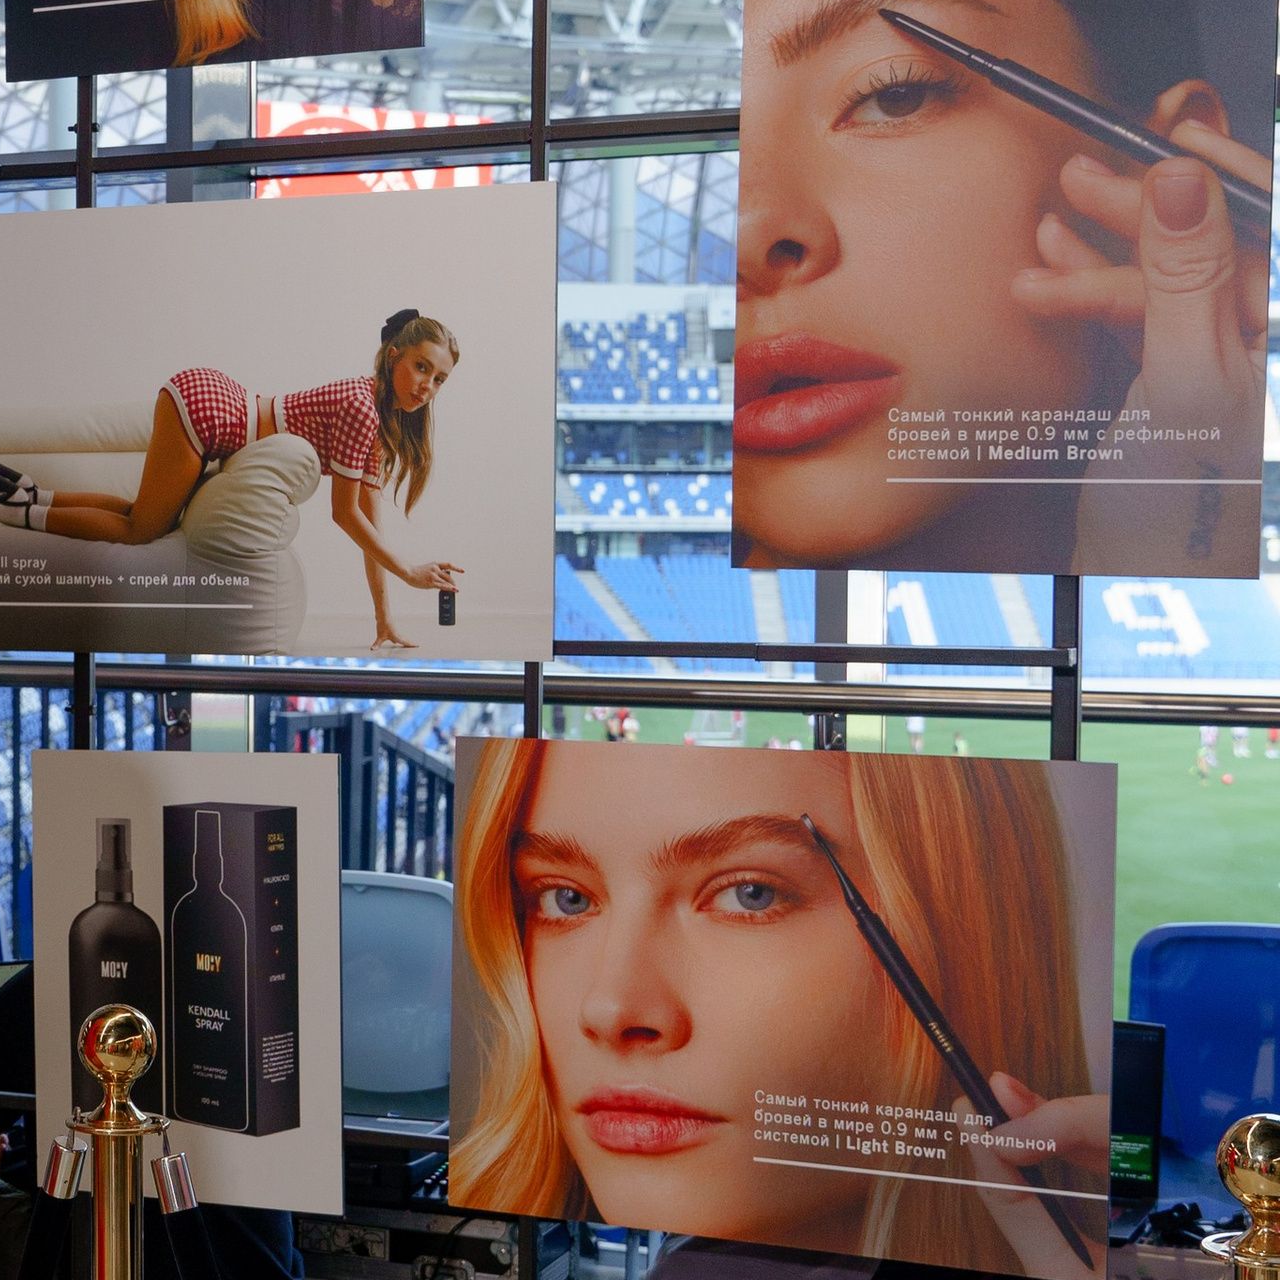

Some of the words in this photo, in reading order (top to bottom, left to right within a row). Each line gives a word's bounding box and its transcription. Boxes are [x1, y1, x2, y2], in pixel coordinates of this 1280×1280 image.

[888, 407, 946, 422] Самый
[953, 408, 1014, 422] тонкий
[1021, 408, 1112, 424] карандаш
[1118, 409, 1151, 423] для
[887, 426, 951, 445] бровей
[958, 430, 968, 441] в
[975, 430, 1019, 445] мире
[1026, 426, 1056, 441] 0.9
[1064, 430, 1089, 441] мм
[1096, 430, 1106, 441] с
[1114, 426, 1221, 445] рефильной
[887, 445, 970, 461] системой
[989, 445, 1059, 460] Medium
[1066, 445, 1123, 461] Brown
[12, 558, 47, 570] spray
[15, 573, 51, 587] сухой
[56, 575, 113, 587] шампунь
[129, 573, 168, 588] спрей
[172, 575, 196, 587] для
[200, 572, 250, 587] объема
[188, 1004, 231, 1021] KENDALL
[195, 1018, 224, 1032] SPRAY
[754, 1090, 807, 1108] Самый
[813, 1097, 869, 1114] тонкий
[875, 1104, 957, 1124] карандаш
[963, 1112, 993, 1127] для
[753, 1109, 812, 1128] бровей
[818, 1117, 827, 1129] в
[834, 1119, 874, 1136] мире
[880, 1121, 907, 1136] 0.9
[914, 1128, 937, 1140] мм
[944, 1130, 953, 1141] с
[960, 1131, 1056, 1153] рефильной
[753, 1128, 830, 1147] системой
[846, 1135, 888, 1155] Light
[895, 1140, 946, 1160] Brown
